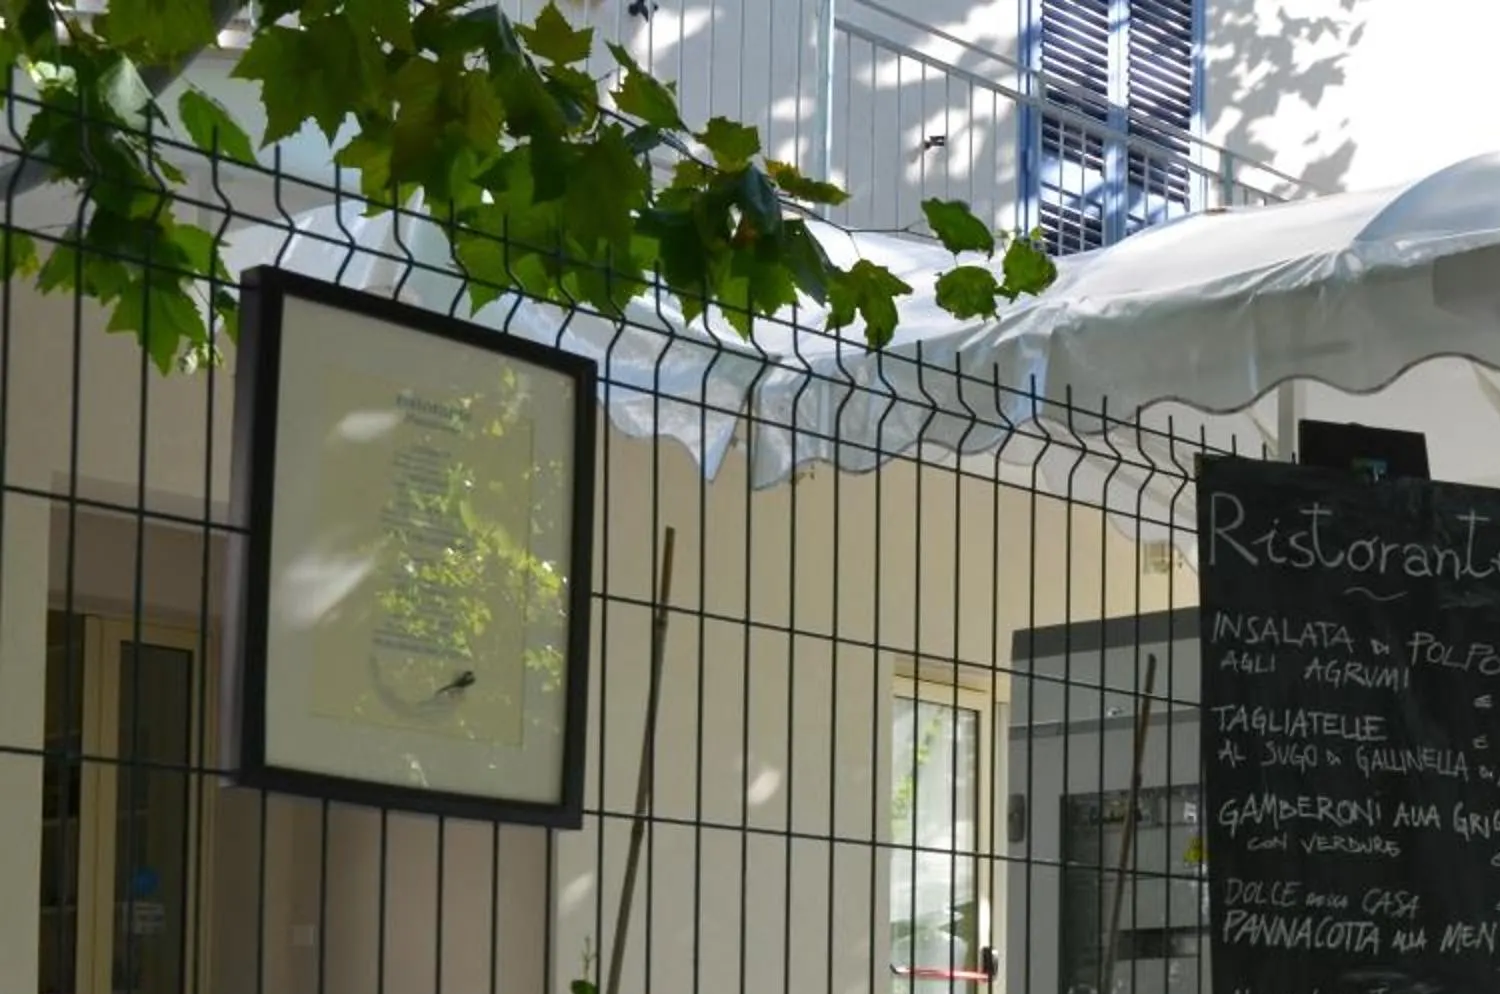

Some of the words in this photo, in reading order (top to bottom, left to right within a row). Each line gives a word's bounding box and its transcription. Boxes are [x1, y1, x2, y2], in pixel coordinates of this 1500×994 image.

[1211, 609, 1355, 654] INSALATA
[1220, 649, 1275, 673] AGLI
[1209, 704, 1388, 742] TAGLIATELLE
[1218, 739, 1246, 768] AL
[1260, 740, 1318, 774] SUGO
[1355, 745, 1469, 782] GALLINELLA
[1219, 792, 1382, 838] GAMBERONI
[1300, 832, 1401, 858] VERDURE
[1223, 878, 1301, 908] DOLCE
[1361, 888, 1420, 920] CASA
[1222, 910, 1381, 955] PANNACOTTA
